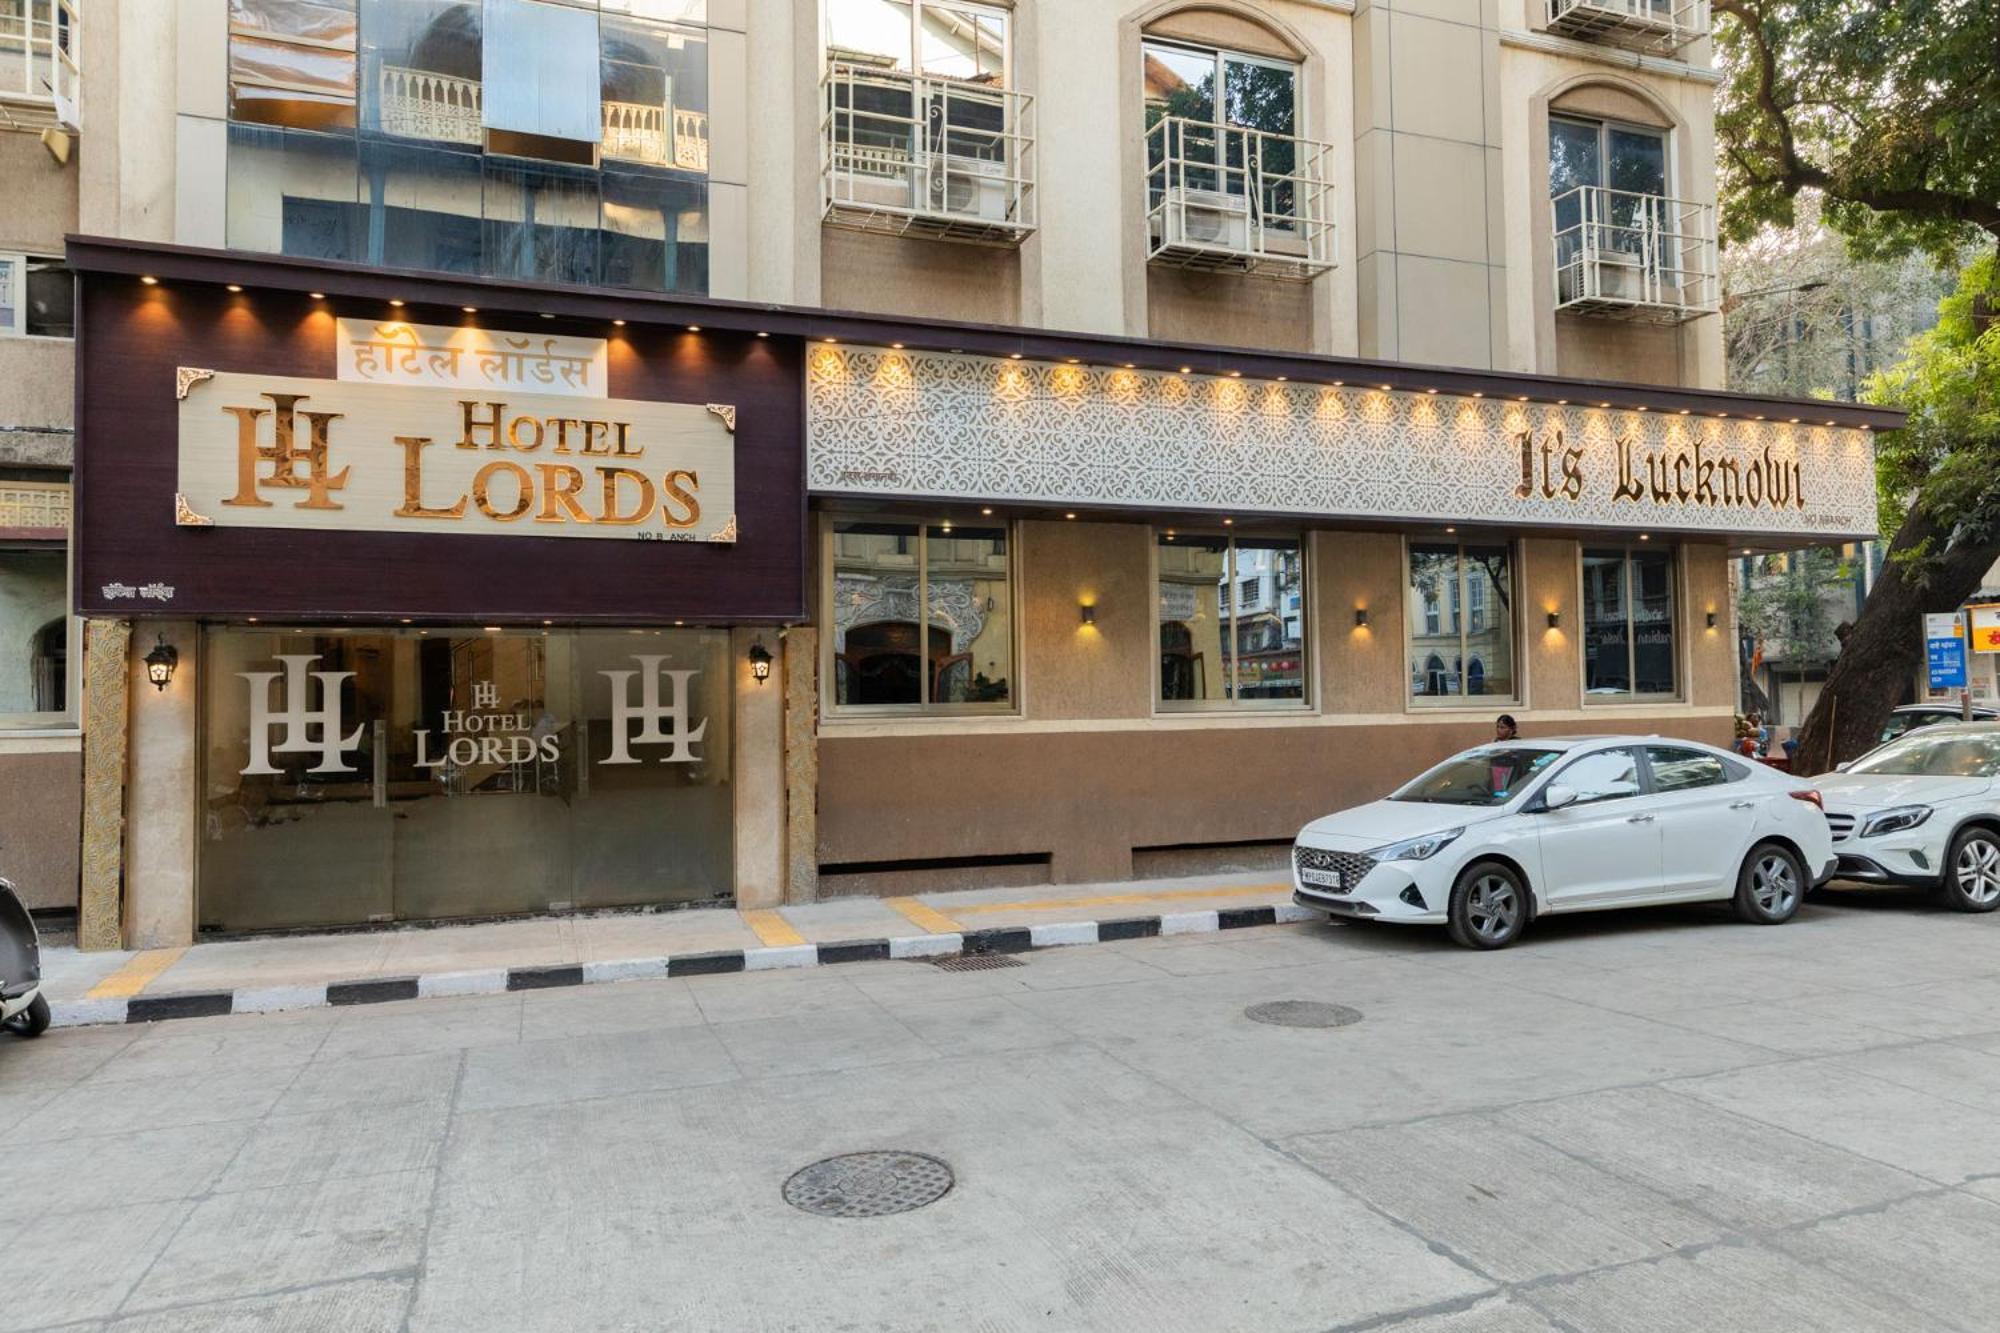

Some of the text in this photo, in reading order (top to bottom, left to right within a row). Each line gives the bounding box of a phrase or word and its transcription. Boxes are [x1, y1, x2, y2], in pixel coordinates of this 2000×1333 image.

[350, 326, 465, 380] हॉटेल
[455, 400, 645, 458] HOTEL
[393, 436, 701, 528] LORDS
[1514, 430, 1584, 501] It's
[638, 531, 653, 541] NO
[413, 729, 560, 768] LORDS
[441, 710, 531, 734] HOTEL
